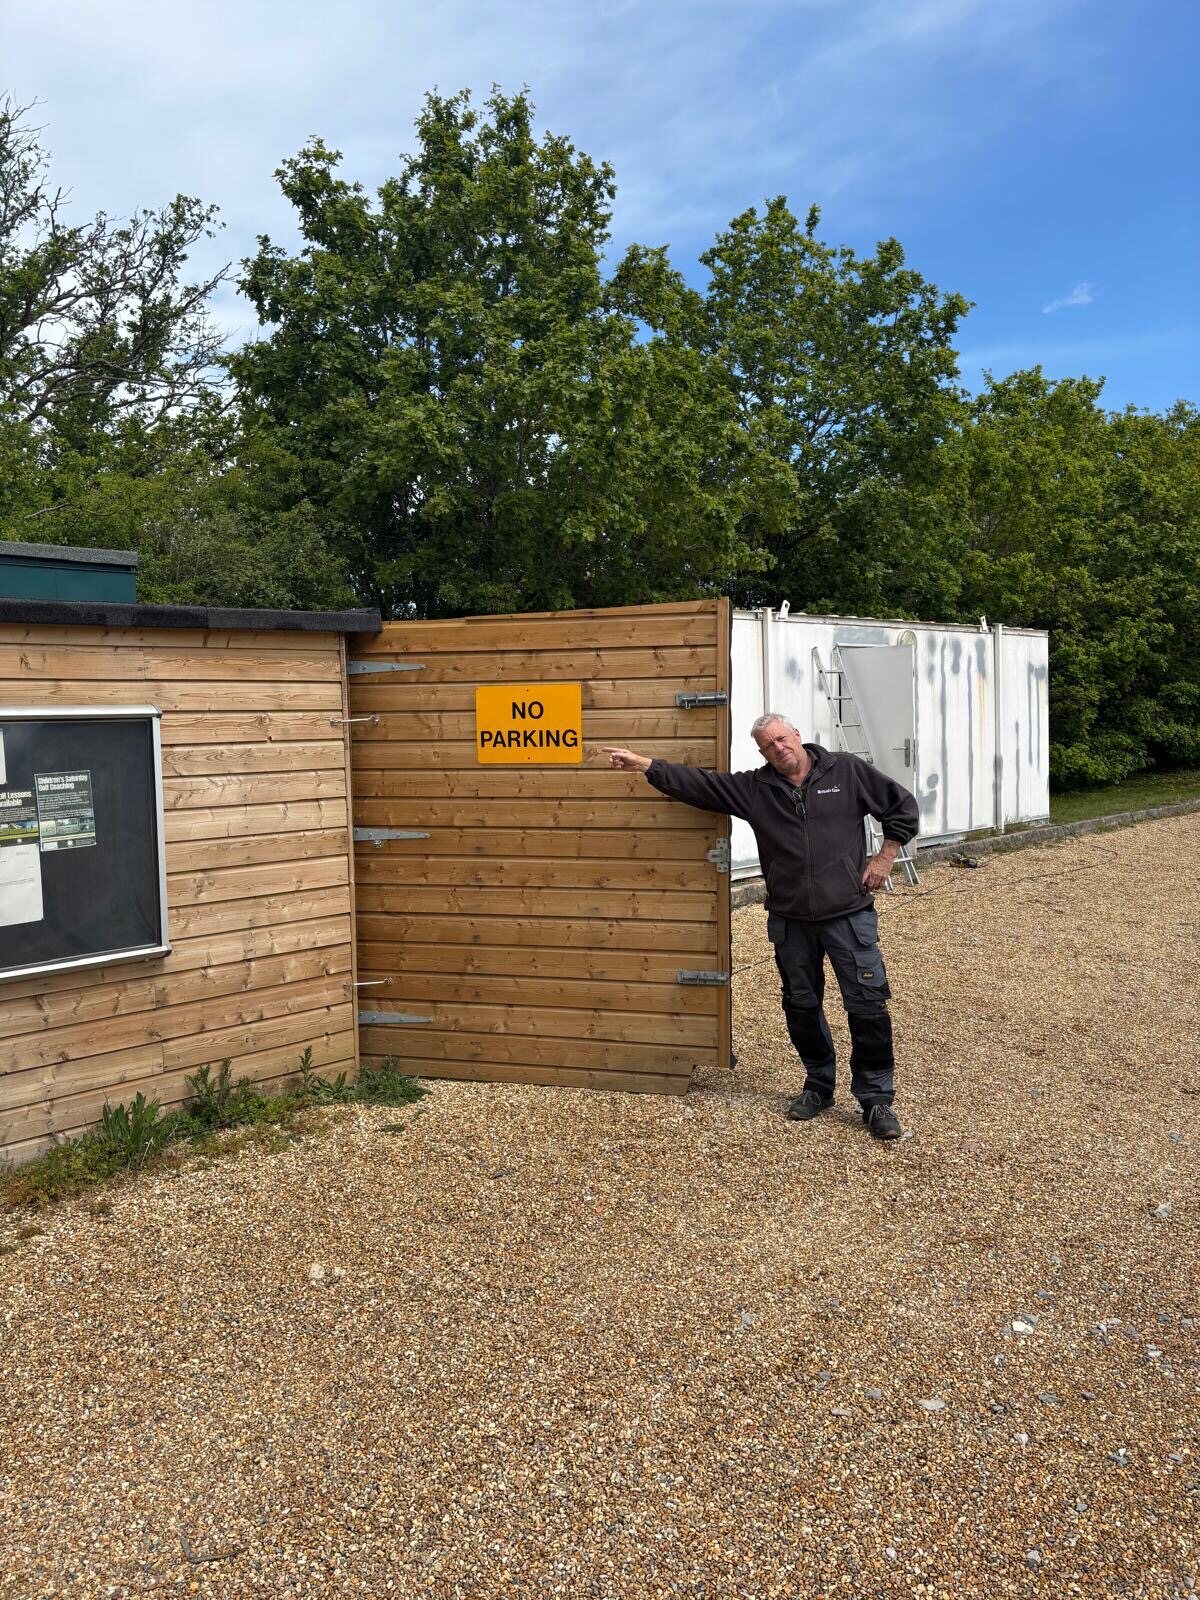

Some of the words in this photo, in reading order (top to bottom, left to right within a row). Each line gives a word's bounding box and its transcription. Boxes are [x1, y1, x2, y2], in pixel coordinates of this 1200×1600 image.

[512, 701, 544, 719] NO
[480, 729, 578, 748] PARKING
[65, 775, 88, 783] Saturday
[50, 783, 74, 791] Coaching
[7, 791, 32, 799] Lessons
